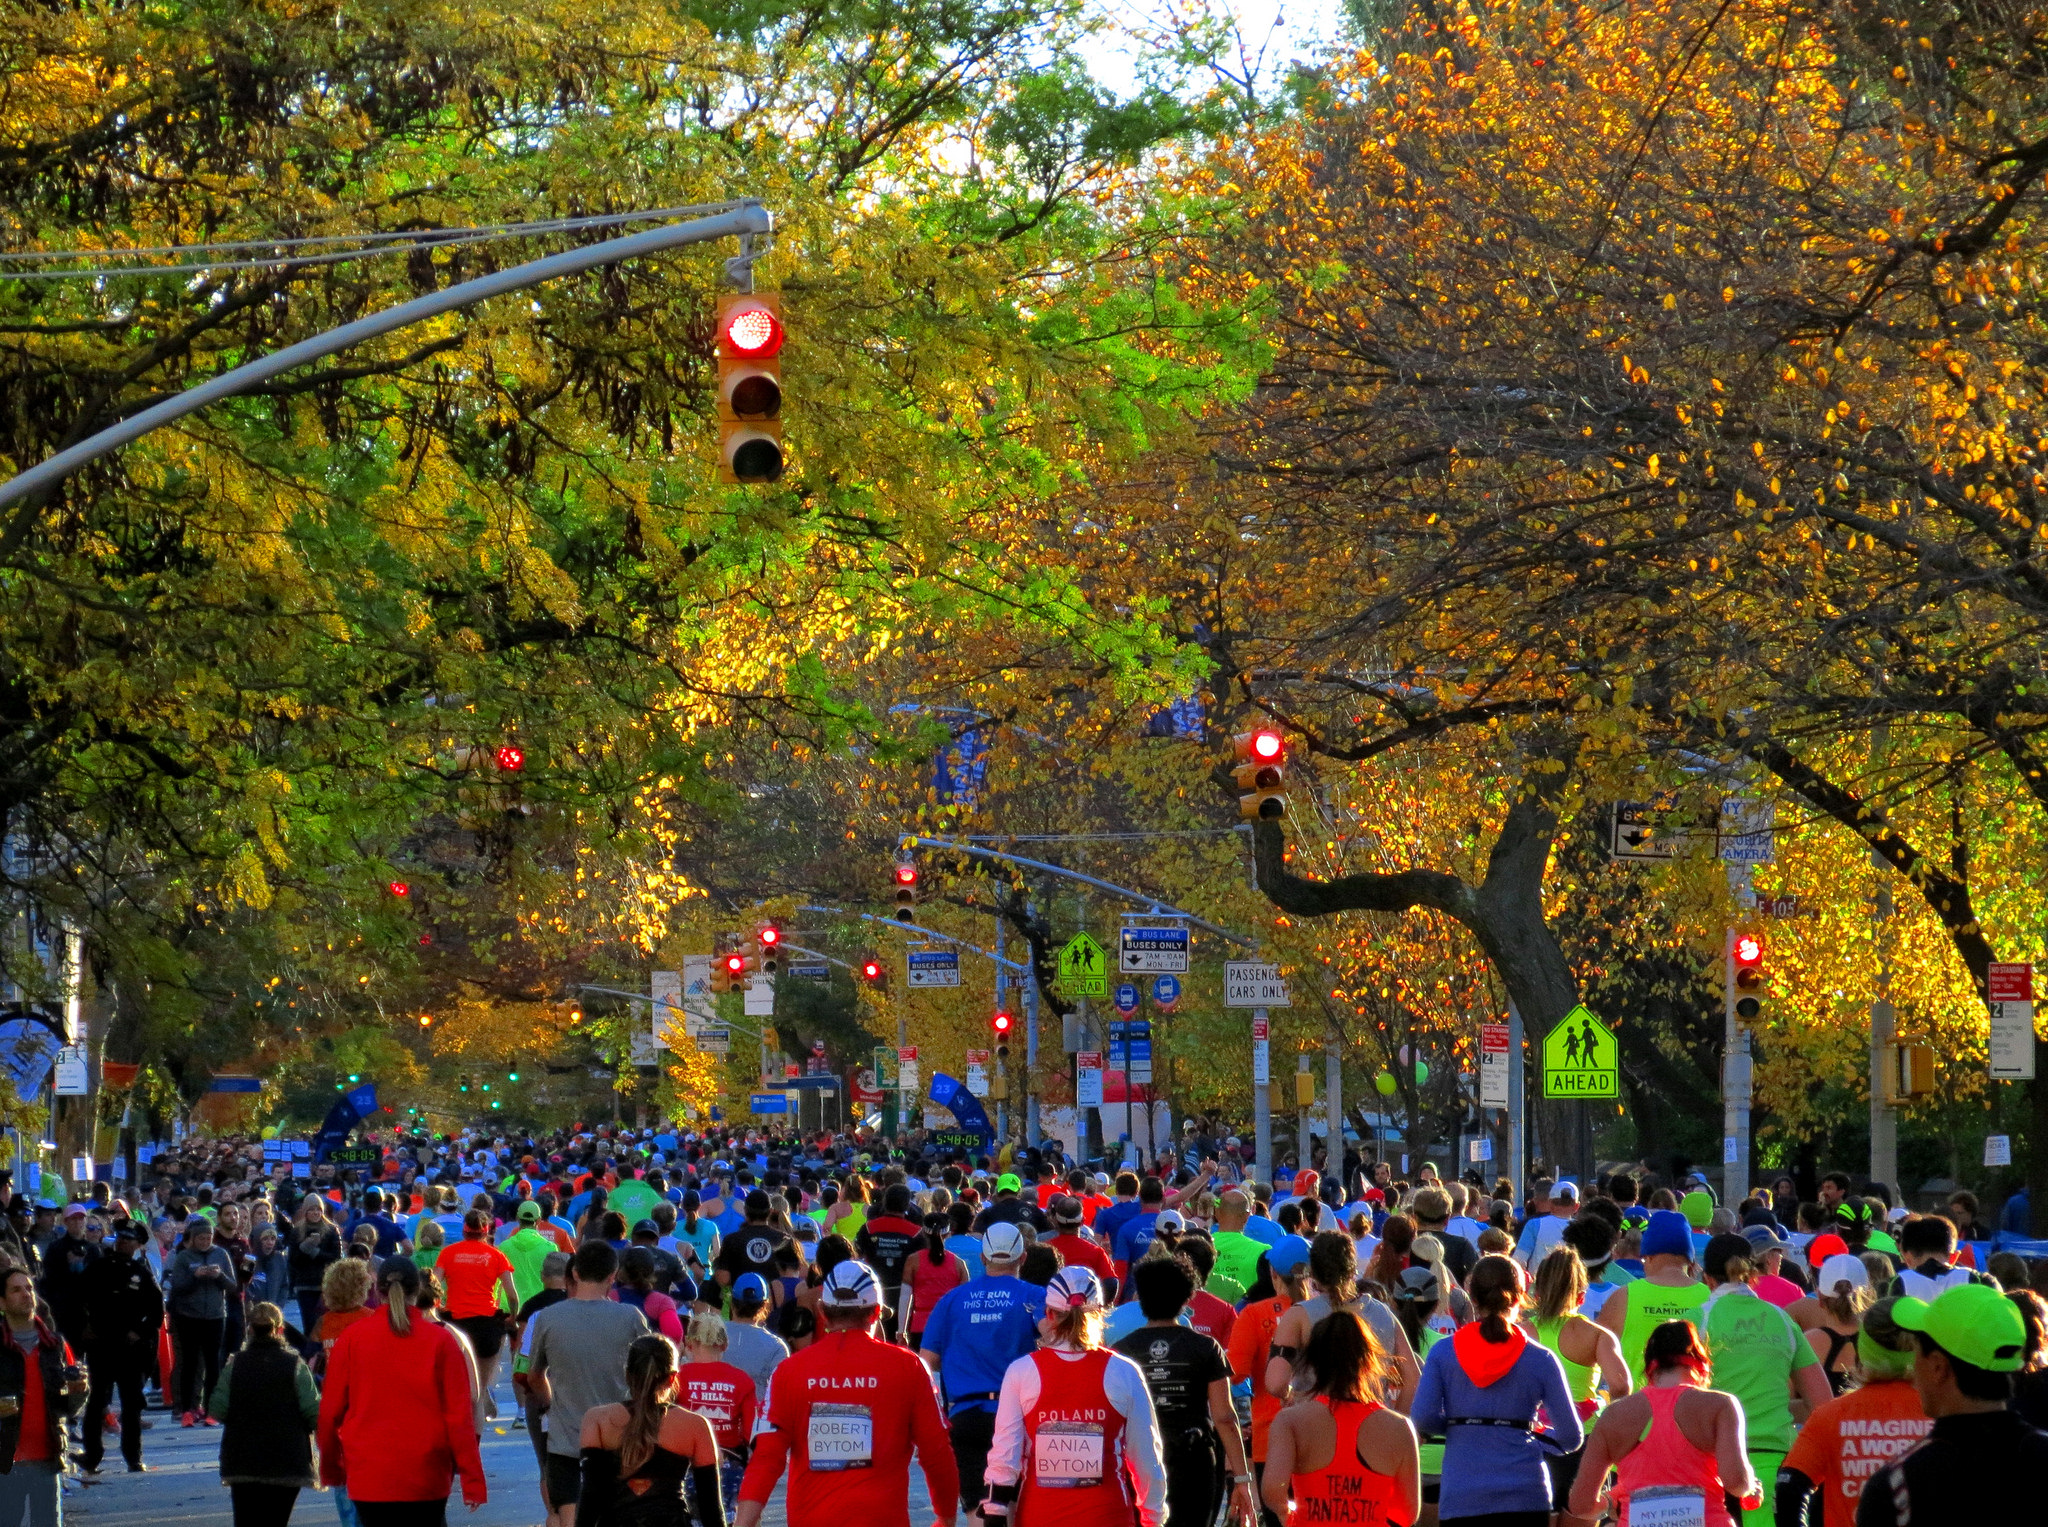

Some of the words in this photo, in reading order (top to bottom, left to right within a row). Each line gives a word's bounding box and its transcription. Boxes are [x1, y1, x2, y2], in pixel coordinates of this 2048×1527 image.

[1721, 849, 1769, 860] AMERA
[1771, 901, 1795, 918] 105
[1142, 928, 1159, 939] BUS
[1161, 928, 1181, 939] LANE
[1126, 941, 1157, 950] BUSES
[1159, 941, 1183, 950] ONLY
[1230, 968, 1285, 980] PASSENG
[1991, 966, 2000, 974] NO
[2000, 966, 2025, 974] STANDING
[1229, 985, 1255, 998] CARS
[1262, 985, 1286, 998] ONLY
[1993, 1002, 2000, 1017] 2
[57, 1052, 63, 1063] 2
[1484, 1053, 1491, 1064] 2
[935, 1084, 951, 1094] 23
[1553, 1074, 1609, 1091] AHEAD
[970, 1291, 985, 1299] WE
[987, 1290, 1011, 1299] RUN
[963, 1300, 981, 1309] THIS
[984, 1299, 1014, 1308] TOWN
[687, 1381, 708, 1391] IT'S
[709, 1381, 736, 1393] JUST
[807, 1376, 878, 1390] POLAND
[690, 1391, 698, 1400] A
[1038, 1408, 1107, 1423] POLAND
[809, 1422, 870, 1435] ROBERT
[814, 1440, 865, 1453] BYTOM
[1046, 1438, 1091, 1453] ANIA
[1842, 1440, 1859, 1457] A
[1038, 1458, 1099, 1473] BYTOM
[1326, 1475, 1363, 1496] TEAM
[1641, 1511, 1657, 1520] MY
[1661, 1507, 1691, 1518] FIRST
